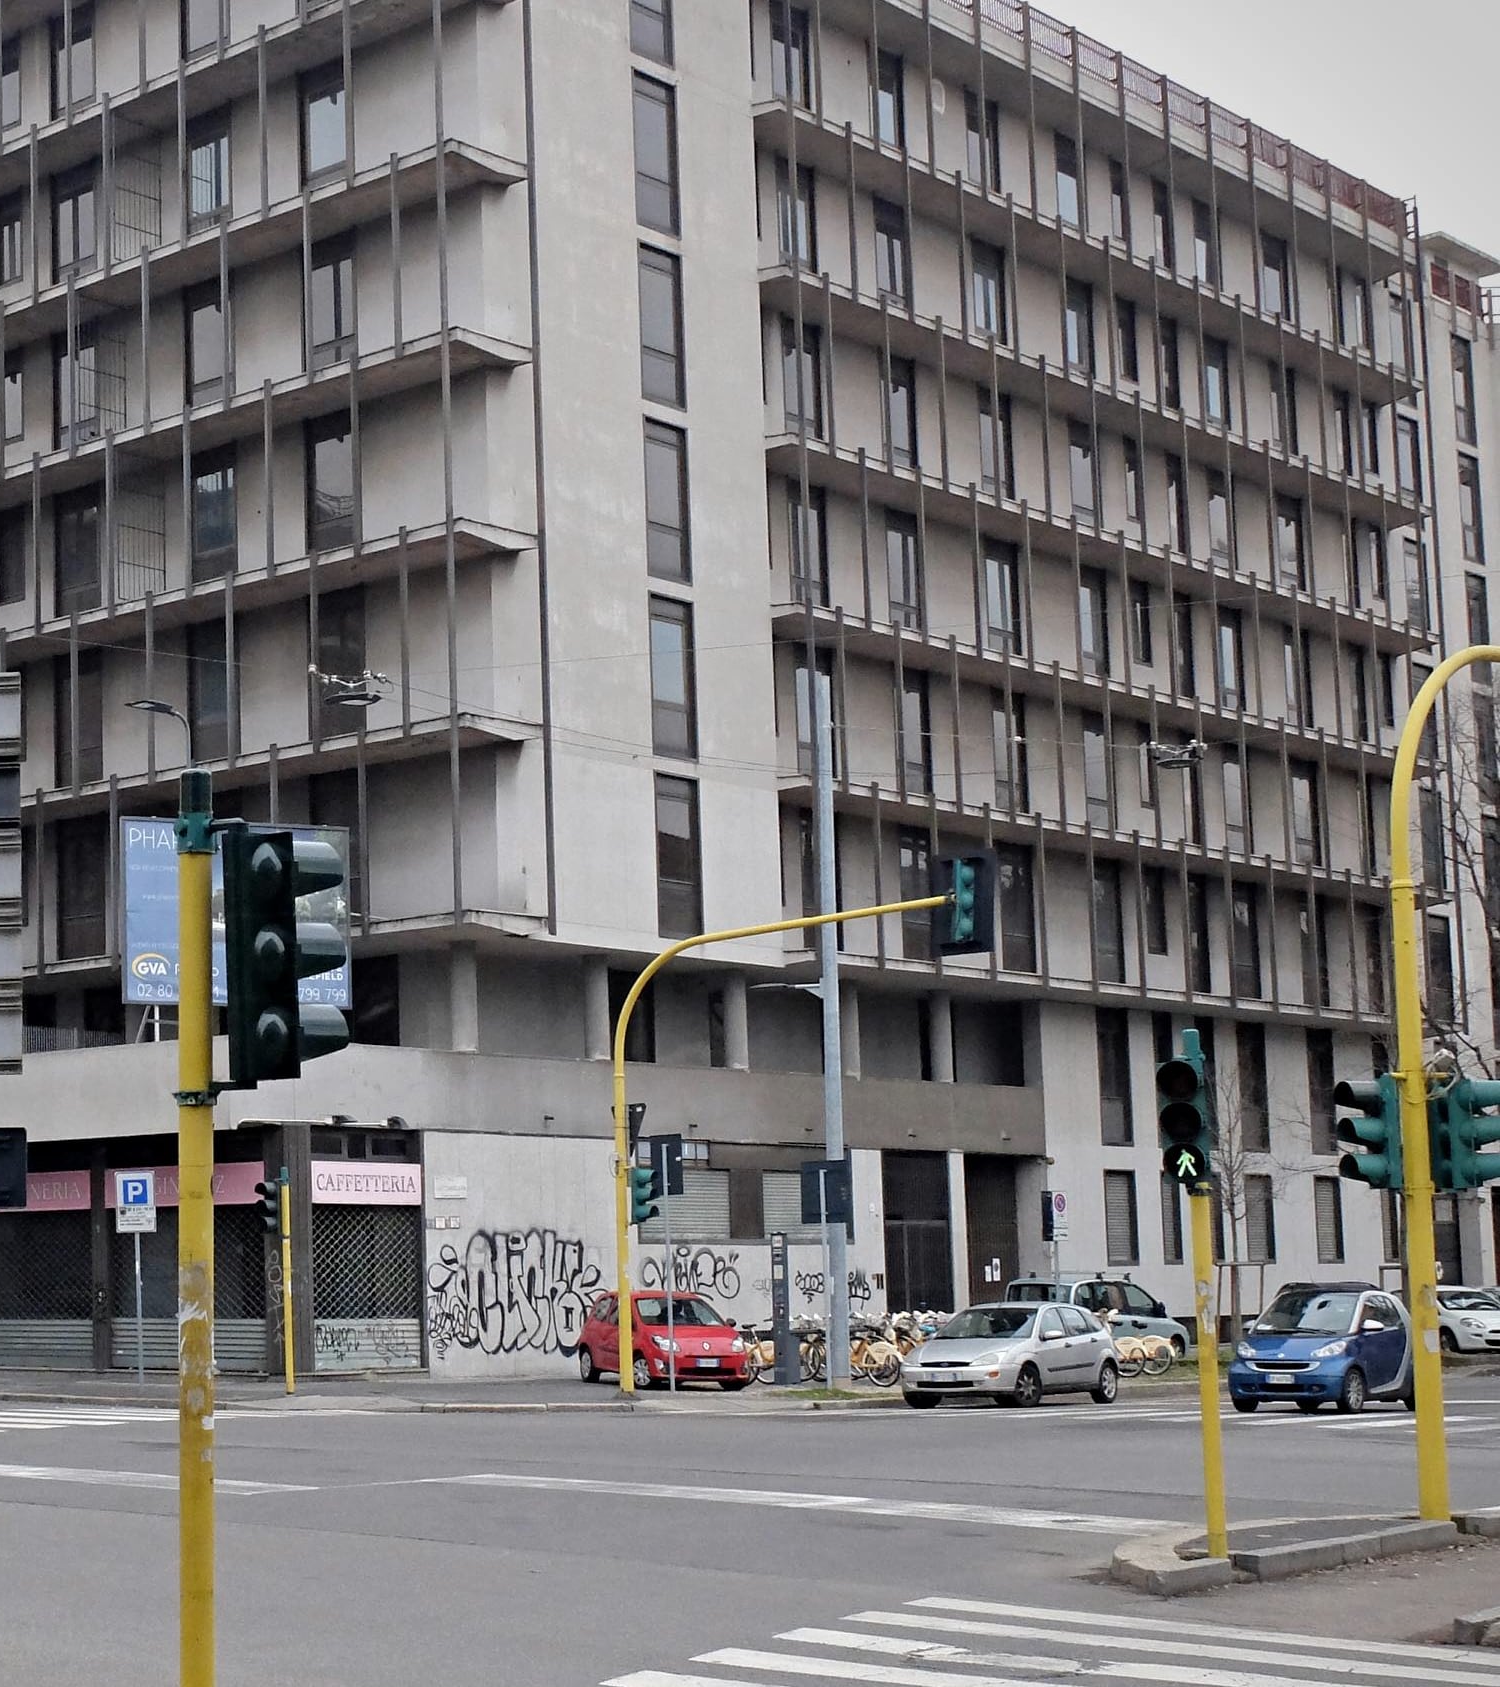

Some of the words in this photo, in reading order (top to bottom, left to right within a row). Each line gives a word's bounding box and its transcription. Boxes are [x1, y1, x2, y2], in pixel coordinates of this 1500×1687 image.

[137, 962, 167, 976] GVA
[137, 983, 152, 997] 02
[157, 984, 173, 998] 80
[325, 988, 347, 1002] 799
[316, 1173, 417, 1193] CAFFETTERIA
[127, 1181, 143, 1203] P
